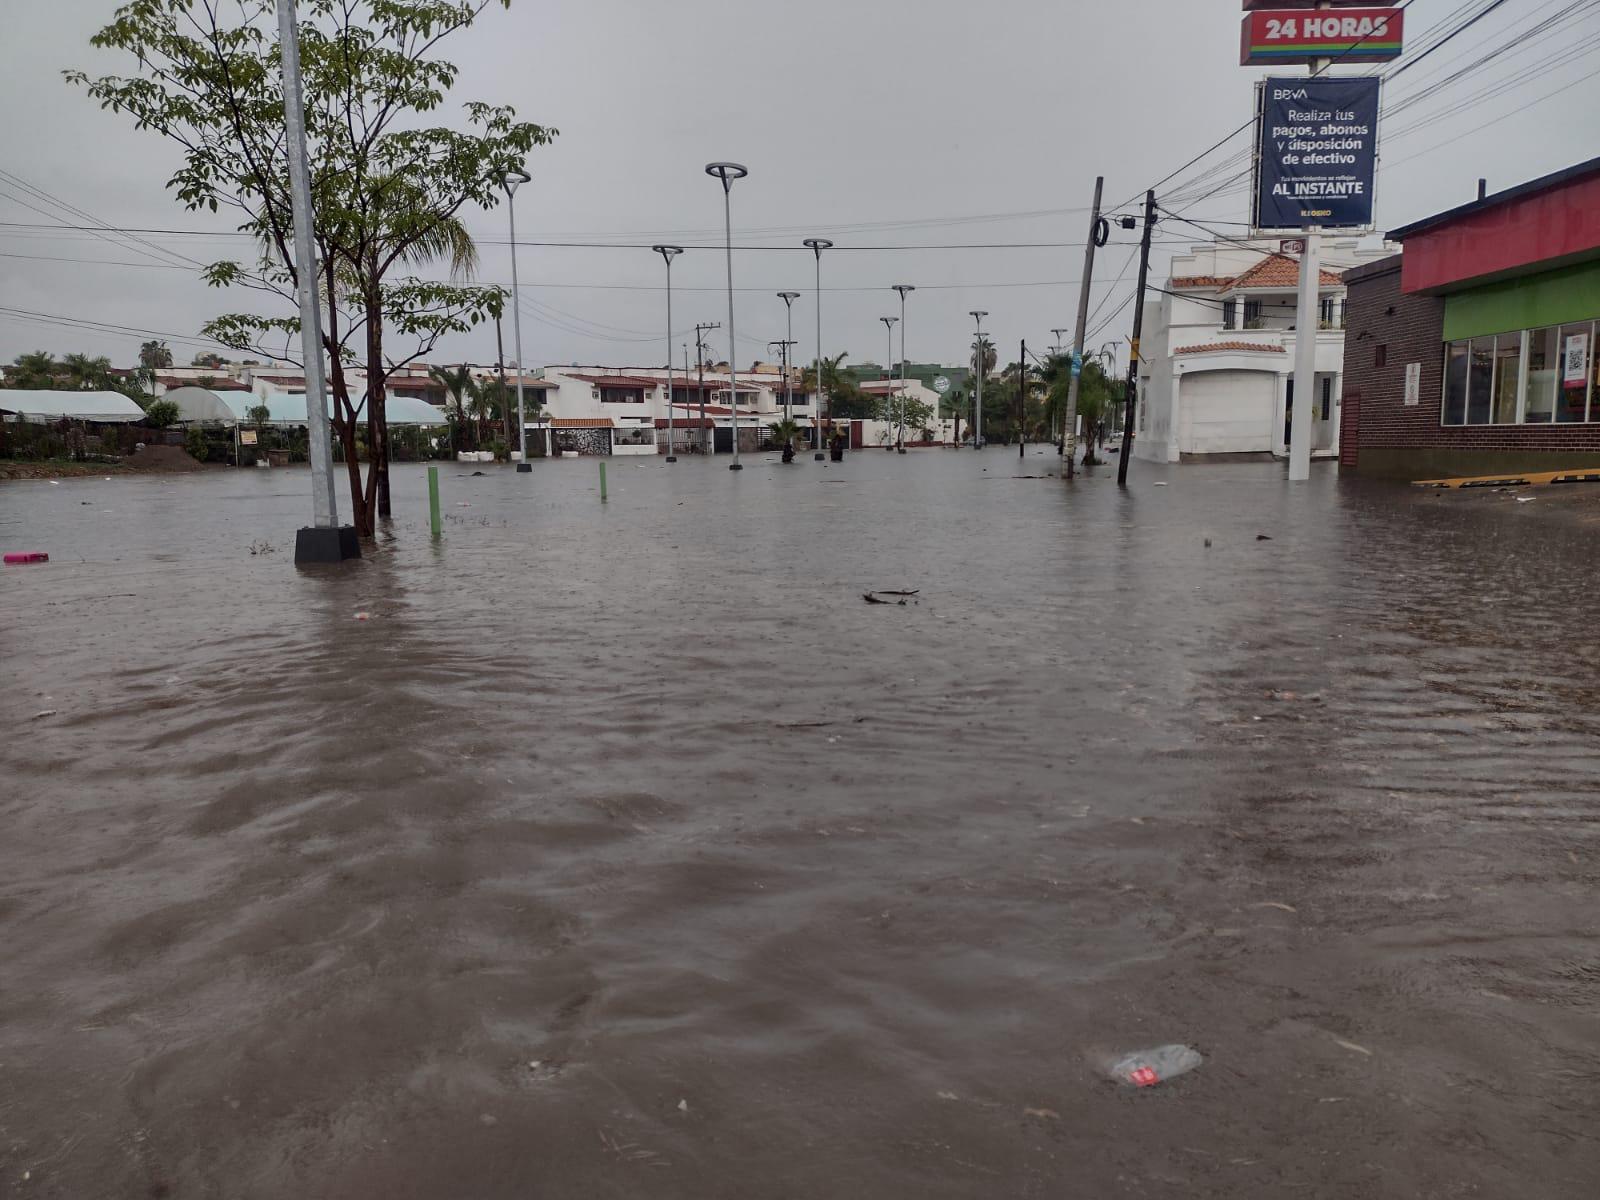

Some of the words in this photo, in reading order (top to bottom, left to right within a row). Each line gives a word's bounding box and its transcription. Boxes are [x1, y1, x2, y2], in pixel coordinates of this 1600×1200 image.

[1265, 19, 1297, 38] 24
[1303, 17, 1388, 38] HORAS
[1273, 89, 1308, 100] BBVA
[1288, 110, 1331, 121] Realiza
[1335, 109, 1354, 121] tus
[1272, 126, 1316, 138] pagos,
[1319, 124, 1368, 136] abonos
[1288, 138, 1362, 151] disposición
[1282, 155, 1299, 165] de
[1302, 153, 1355, 164] efectivo
[1272, 183, 1291, 195] AL
[1295, 182, 1363, 194] INSTANTE
